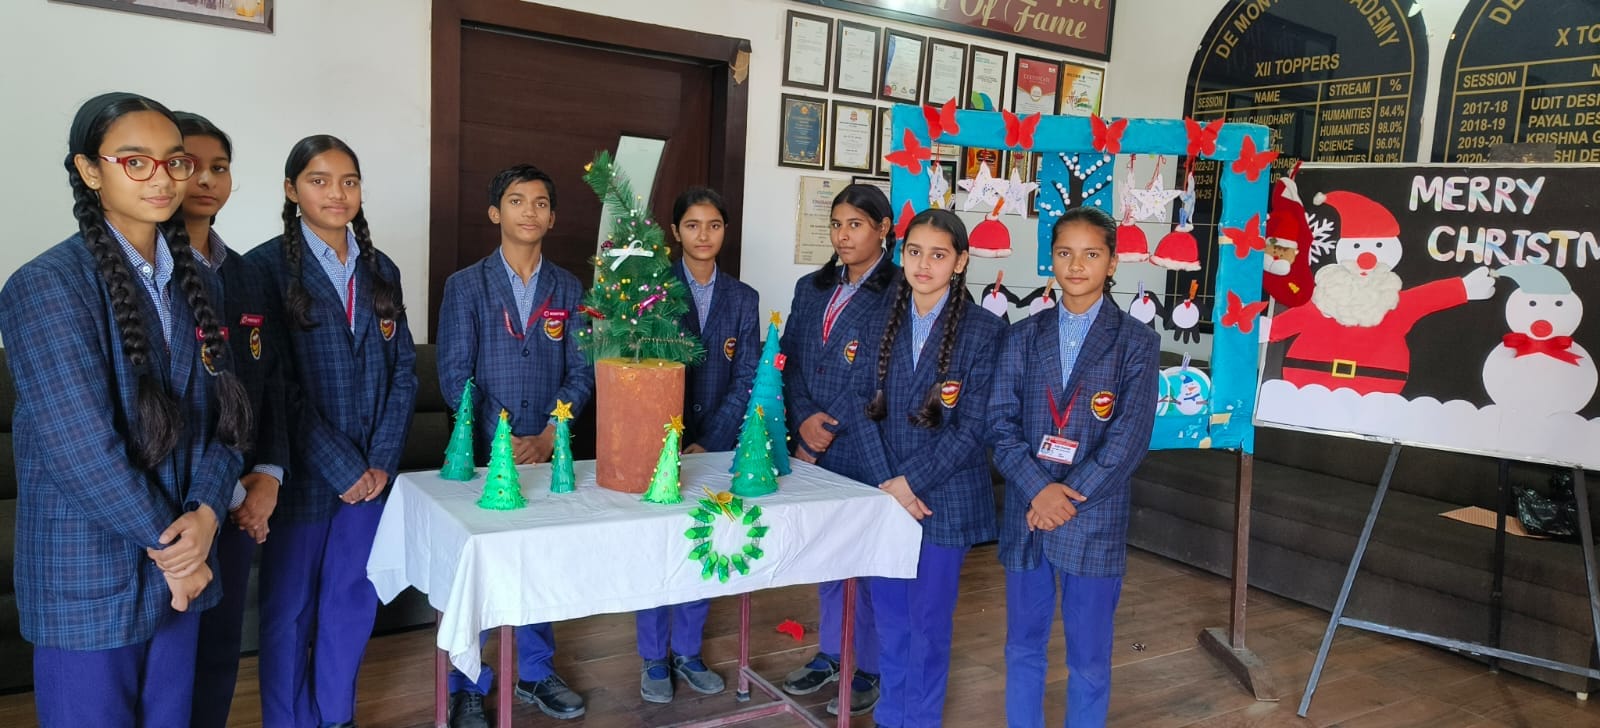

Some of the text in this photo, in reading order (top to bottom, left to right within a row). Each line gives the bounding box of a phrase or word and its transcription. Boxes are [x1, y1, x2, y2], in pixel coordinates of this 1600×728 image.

[1005, 0, 1088, 39] Fame
[1215, 32, 1240, 59] DE
[1233, 0, 1280, 34] MON
[1555, 27, 1571, 47] X
[1254, 53, 1341, 78] XII TOPPERS
[1463, 70, 1517, 88] SESSION
[1197, 78, 1402, 109] SESSION NAME STREAM %
[1321, 106, 1373, 121] HUMANITIES
[1380, 104, 1405, 118] 84.4%
[1462, 100, 1509, 116] 2017-18
[1531, 95, 1564, 111] UDIT
[1319, 122, 1371, 137] HUMANITIES
[1377, 120, 1403, 134] 98.0%
[1459, 117, 1506, 133] 2018-19
[1528, 113, 1571, 129] PAYAL
[1318, 138, 1354, 152] SCIENCE
[1375, 136, 1401, 150] 96.0%
[1457, 135, 1504, 149] 2019-20
[1526, 130, 1588, 145] KRISHNA
[1408, 175, 1546, 215] MERRY
